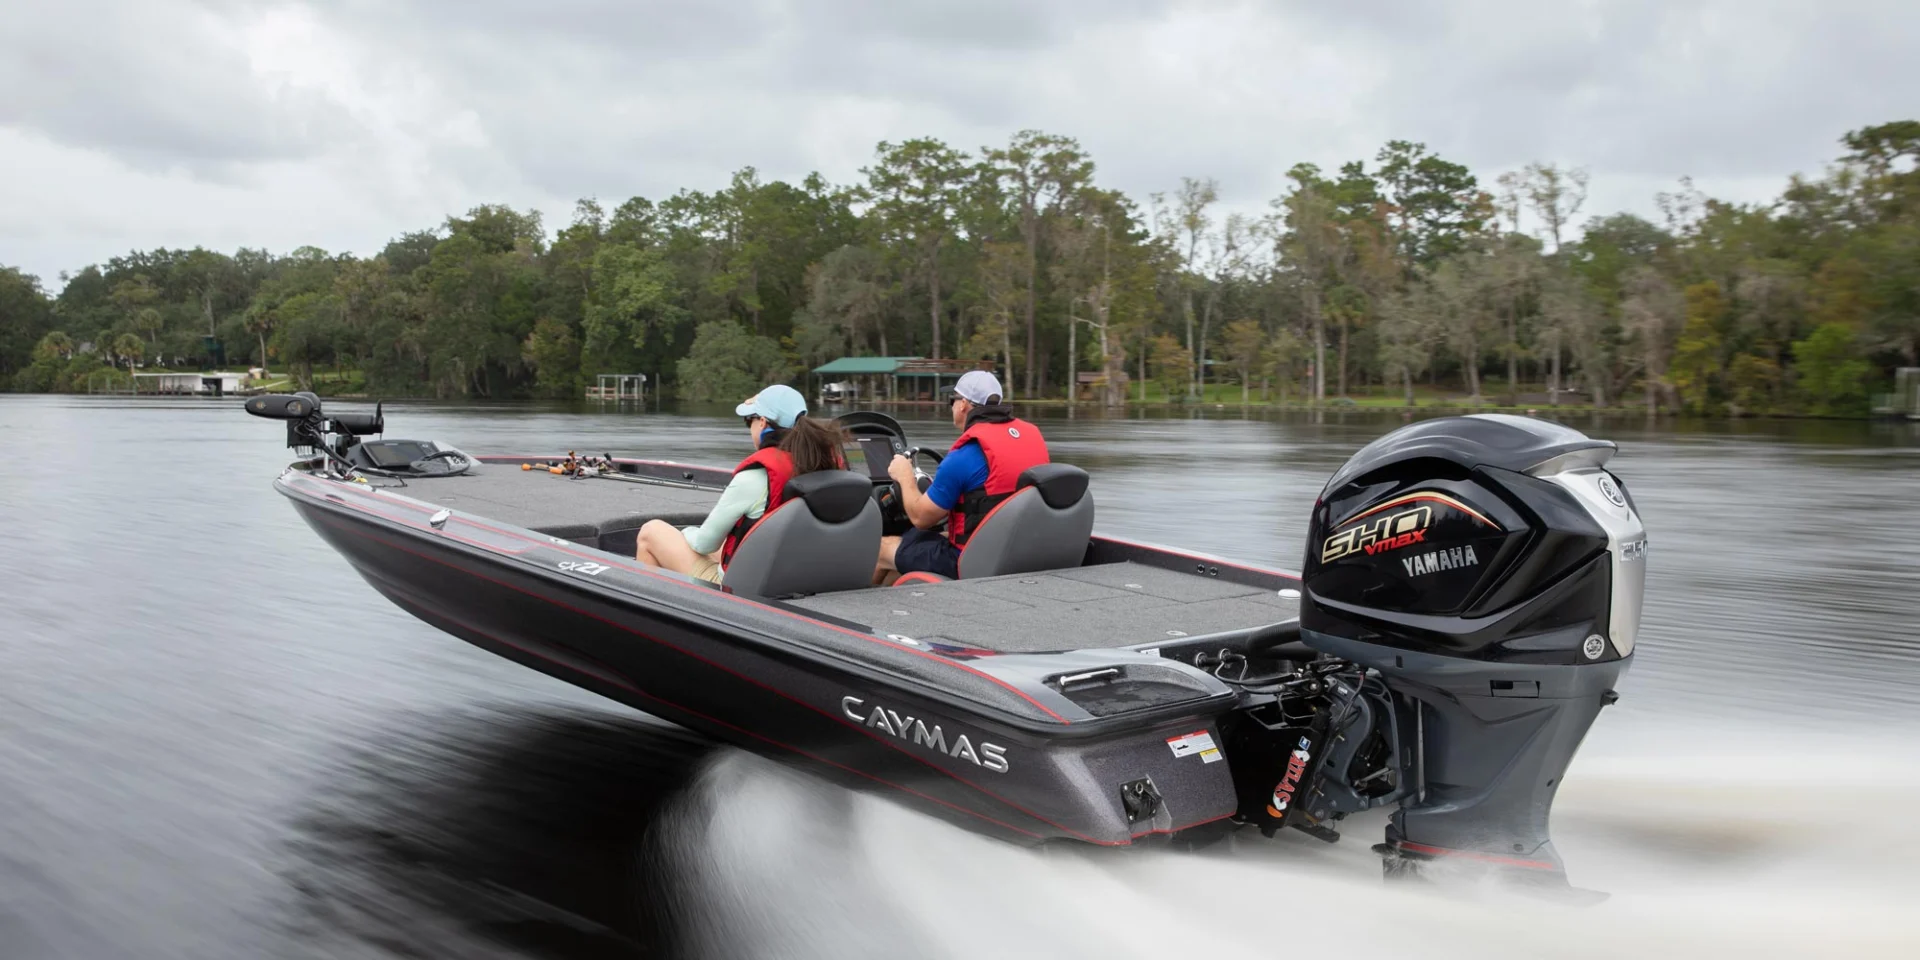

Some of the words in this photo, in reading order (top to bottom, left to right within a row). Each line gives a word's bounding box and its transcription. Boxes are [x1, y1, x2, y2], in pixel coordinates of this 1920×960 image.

[1321, 505, 1432, 564] SHO
[1402, 545, 1479, 577] YAMAHA
[841, 695, 1009, 774] CAYMAS
[1274, 749, 1307, 804] ATLAS
